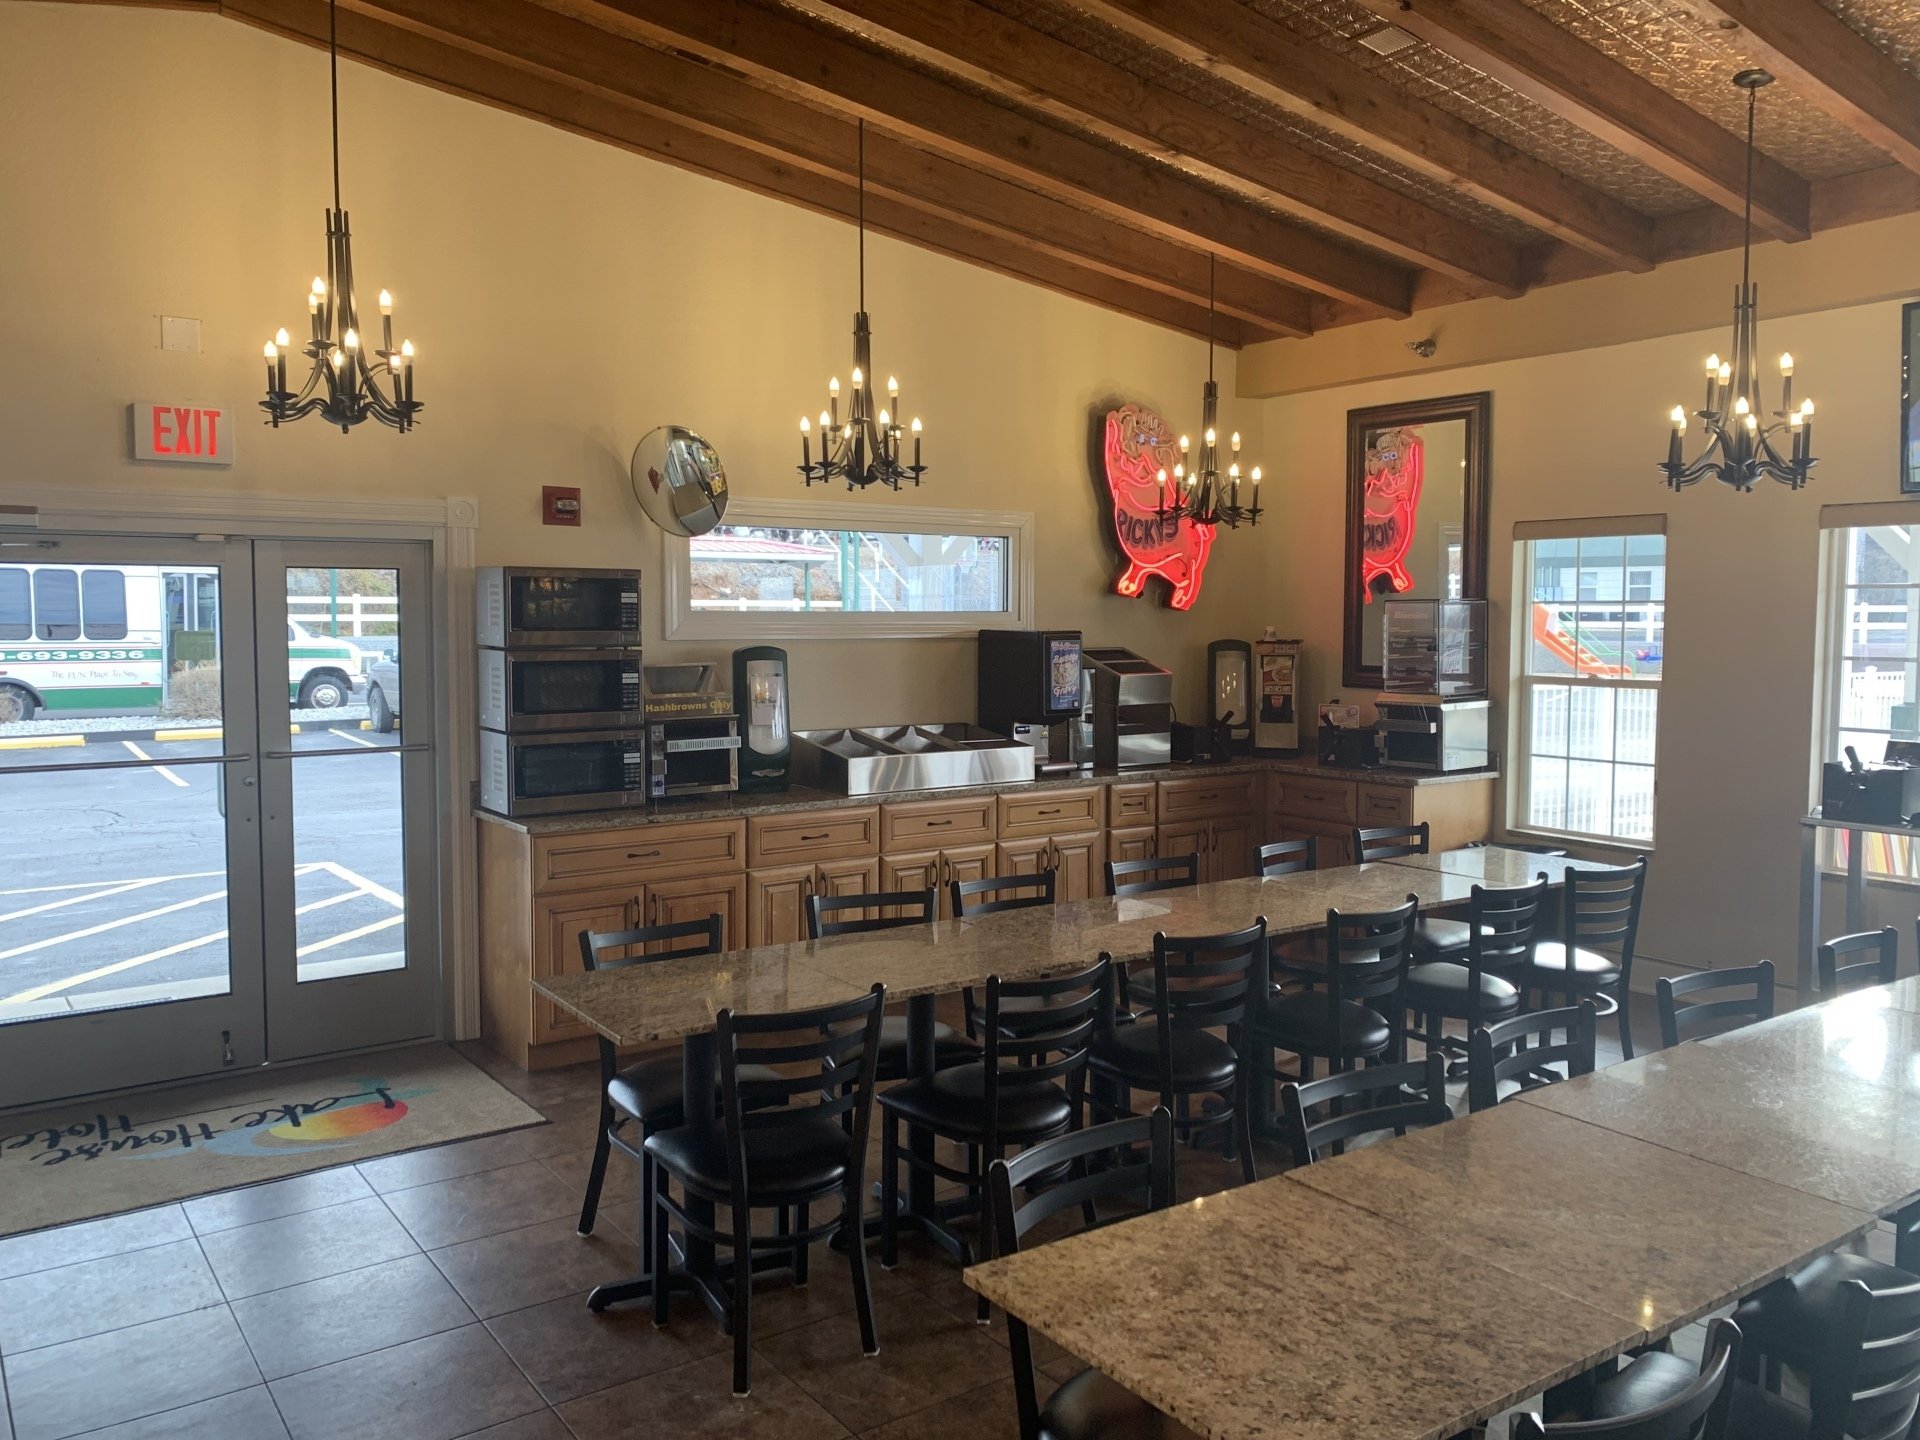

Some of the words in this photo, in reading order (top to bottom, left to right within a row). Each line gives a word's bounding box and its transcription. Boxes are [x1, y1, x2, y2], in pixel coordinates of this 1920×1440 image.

[152, 406, 221, 456] EXIT
[645, 703, 707, 713] Hashbrowns
[229, 1087, 396, 1127] Lake
[0, 1114, 136, 1158] Hote
[30, 1122, 225, 1167] House
